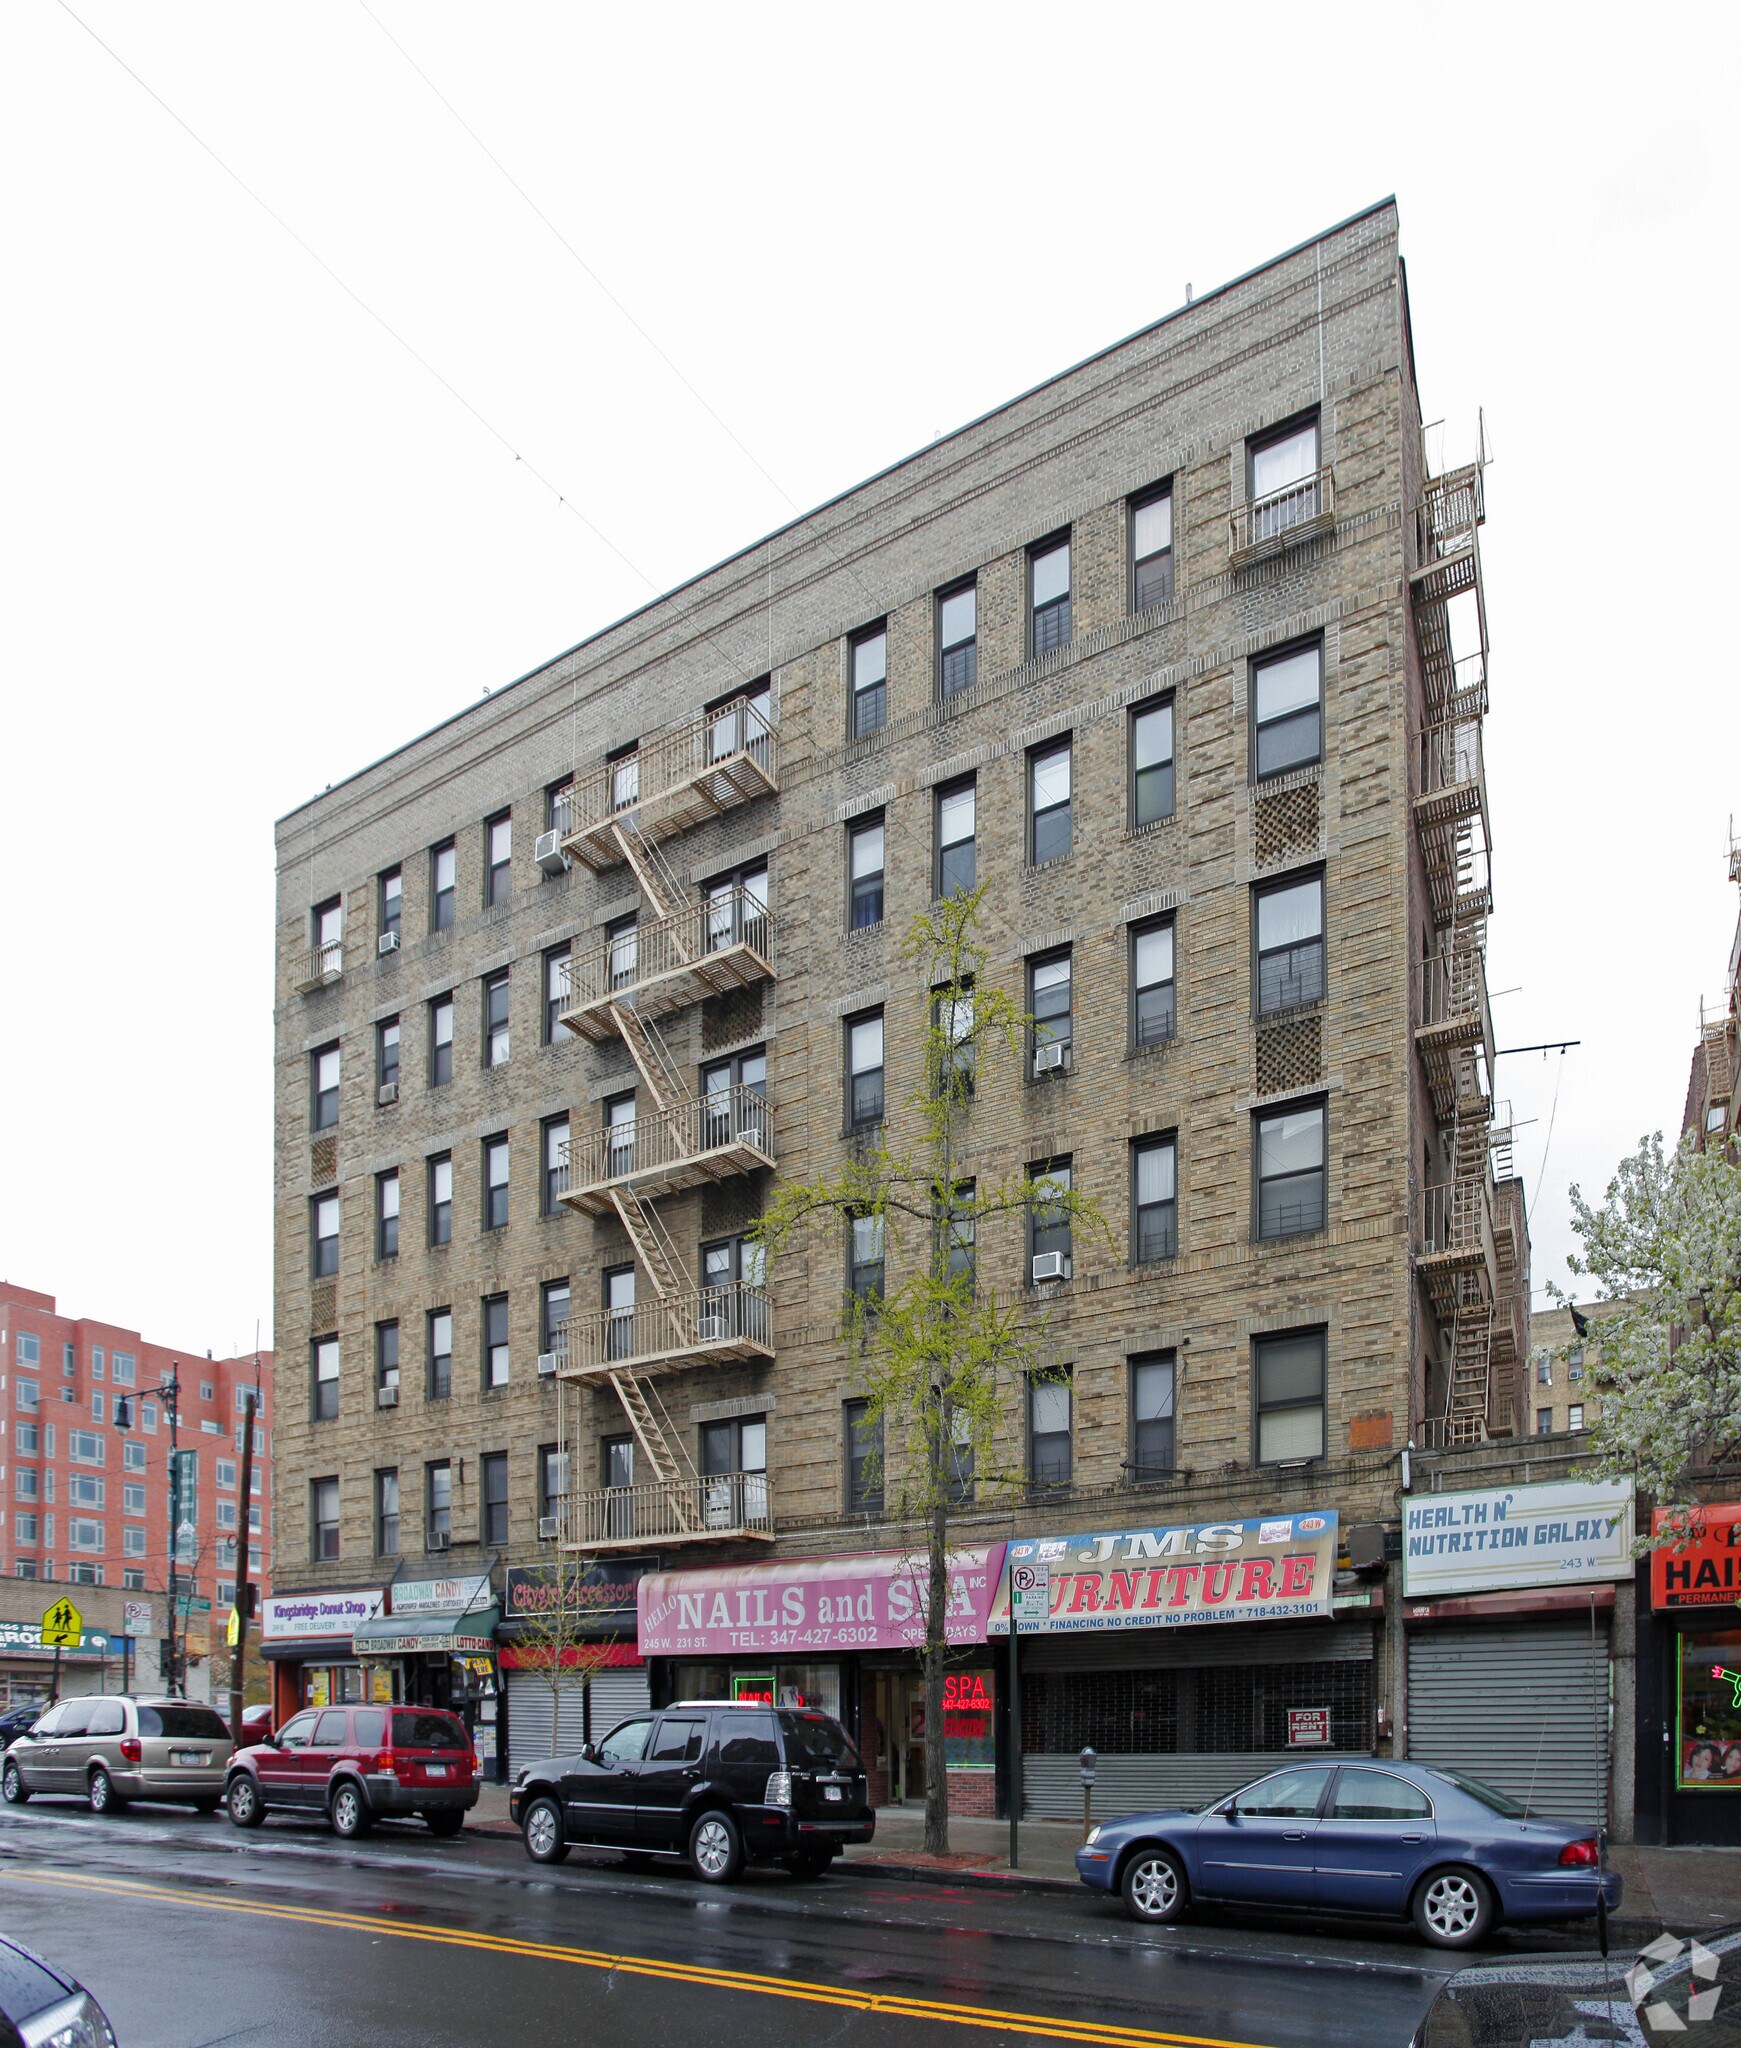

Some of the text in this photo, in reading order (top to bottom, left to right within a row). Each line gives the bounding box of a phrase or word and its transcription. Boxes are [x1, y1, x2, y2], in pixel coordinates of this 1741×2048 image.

[1302, 1520, 1314, 1529] 243
[1408, 1503, 1487, 1530] HEALTH
[1077, 1524, 1244, 1563] JMS
[1408, 1518, 1618, 1556] NUTRITION GALAXY
[1560, 1557, 1596, 1569] 243 W.
[1666, 1558, 1741, 1590] HAI
[394, 1583, 433, 1602] BROADWAY
[435, 1581, 463, 1599] CANDY
[1002, 1553, 1317, 1617] URNITURE
[274, 1601, 367, 1621] Kingsbridge Donut Shop
[644, 1594, 677, 1633] HELLO
[677, 1587, 806, 1630] NAILS
[818, 1584, 875, 1624] and
[969, 1576, 987, 1589] INC
[294, 1622, 309, 1631] FREE
[309, 1621, 336, 1631] DELIVERY
[995, 1603, 1318, 1632] 0% OWN FINANCING NO CREDIT NO PROBLEM 718-432-3101
[370, 1638, 397, 1651] BROADWAY
[398, 1637, 419, 1649] CANDY
[644, 1625, 977, 1649] 245 W. 231 ST. TEL: 347-427-6302 OPE DAYS
[945, 1675, 986, 1699] SPA
[944, 1717, 987, 1738] EDICURE
[1291, 1721, 1326, 1731] RENT
[1295, 1712, 1321, 1721] FOR
